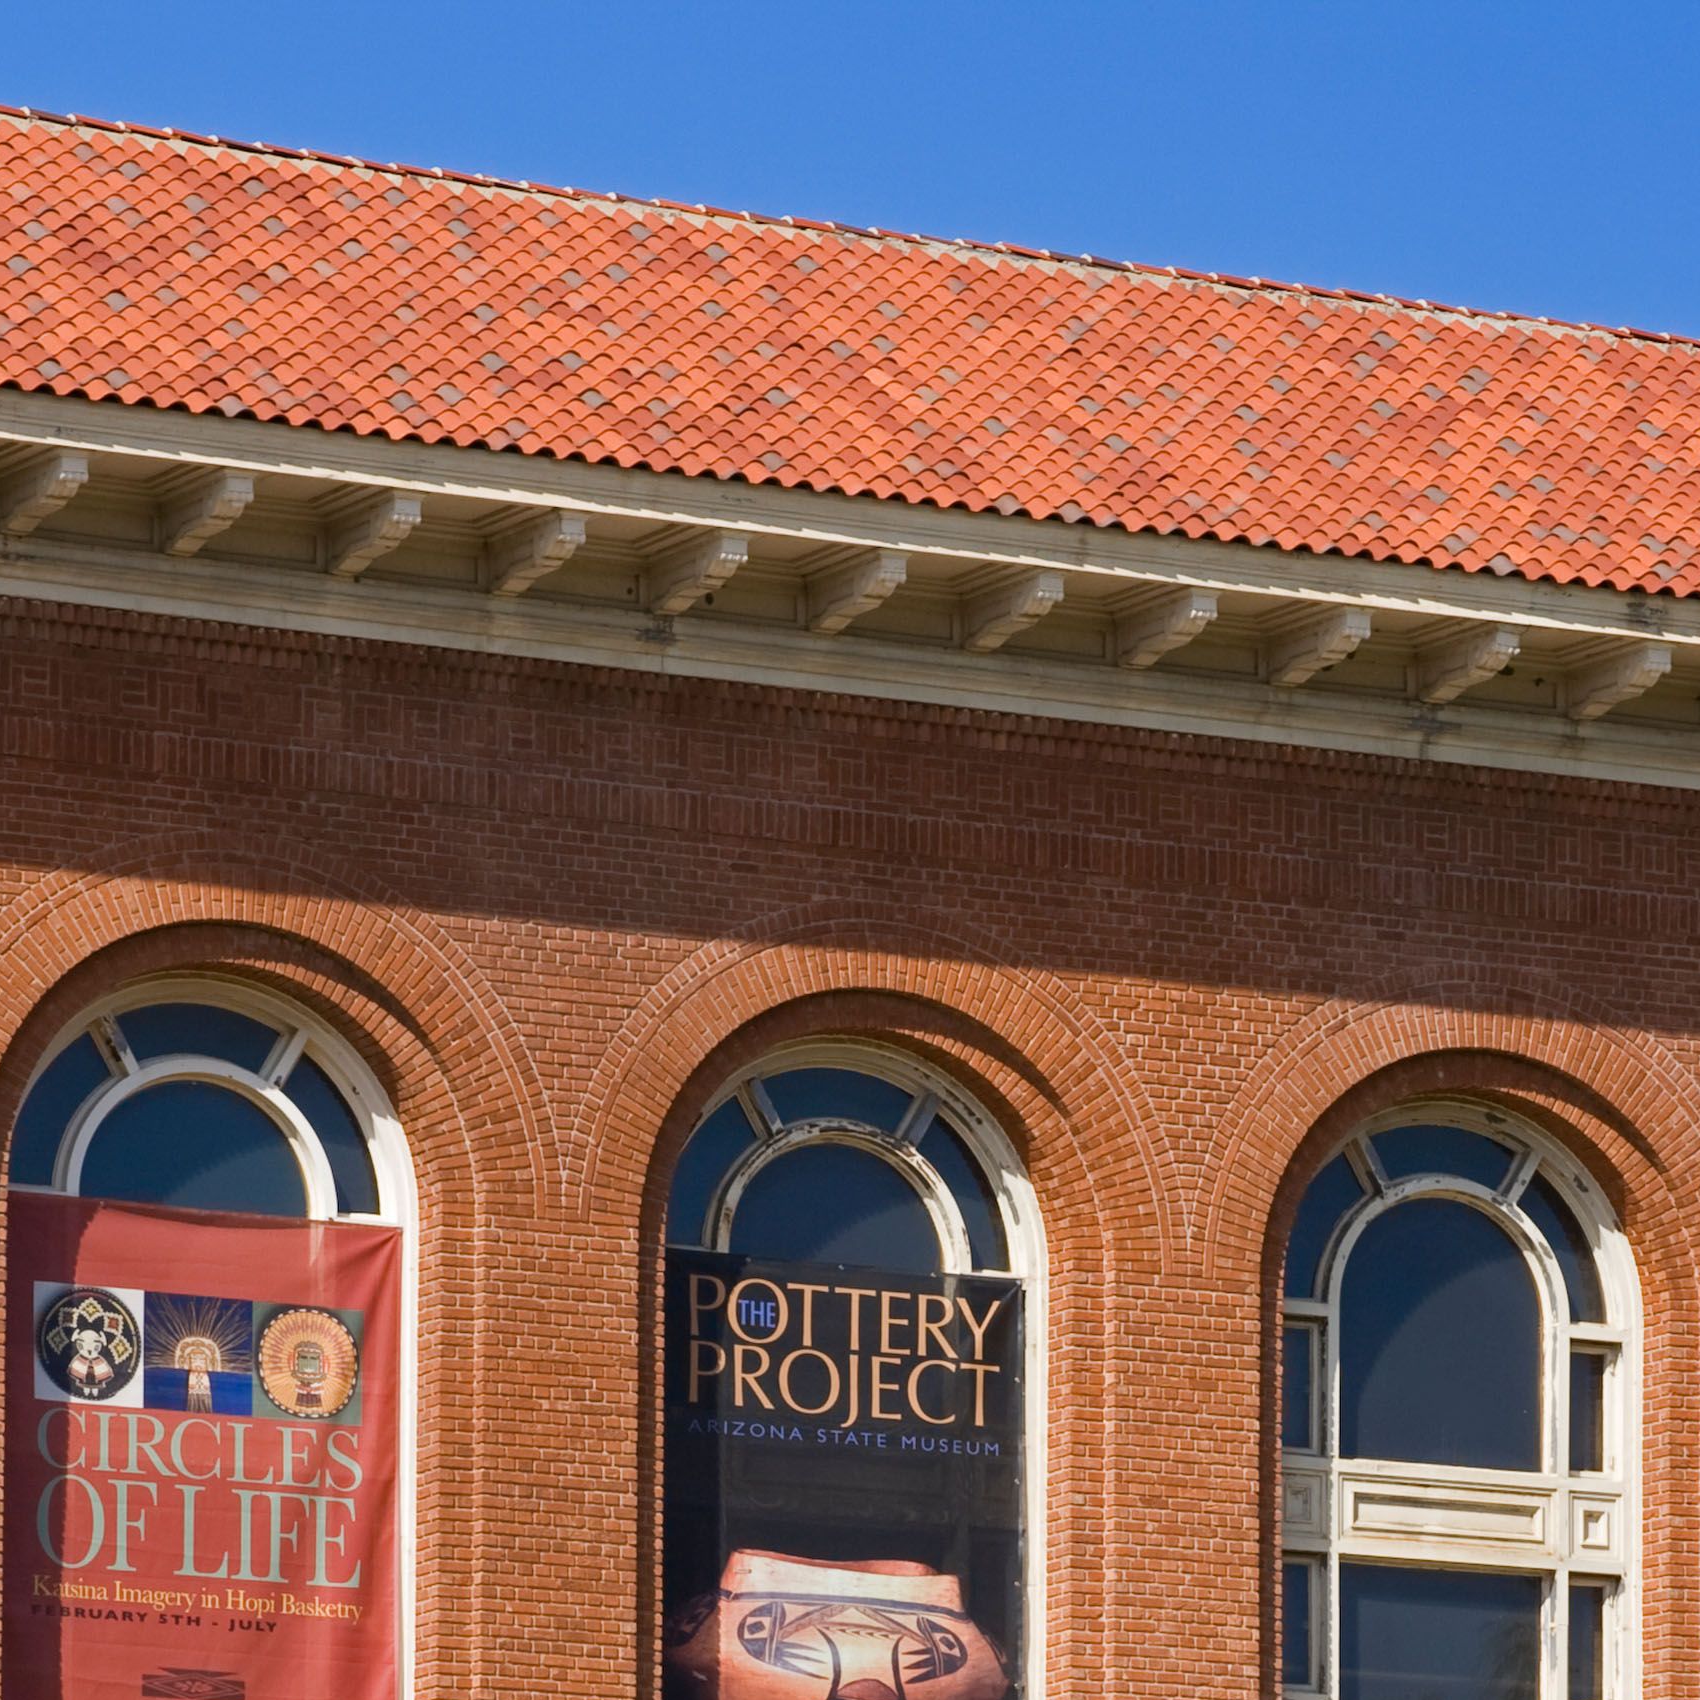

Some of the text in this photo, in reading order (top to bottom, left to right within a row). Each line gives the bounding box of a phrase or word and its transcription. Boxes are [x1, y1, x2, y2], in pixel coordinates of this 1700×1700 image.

[687, 1273, 1001, 1361] POTTERY
[738, 1299, 777, 1329] THE
[687, 1340, 1000, 1428] PROJECT
[36, 1408, 363, 1492] CIRCLES
[688, 1419, 999, 1457] ARIZONA STATE MUSEUM
[36, 1474, 360, 1590] OF LIFE
[30, 1604, 147, 1622] FEBRUARY
[159, 1614, 200, 1627] 5TH
[228, 1618, 277, 1632] JULY
[32, 1575, 363, 1624] Katsina Imagery in Hopi Basketry
